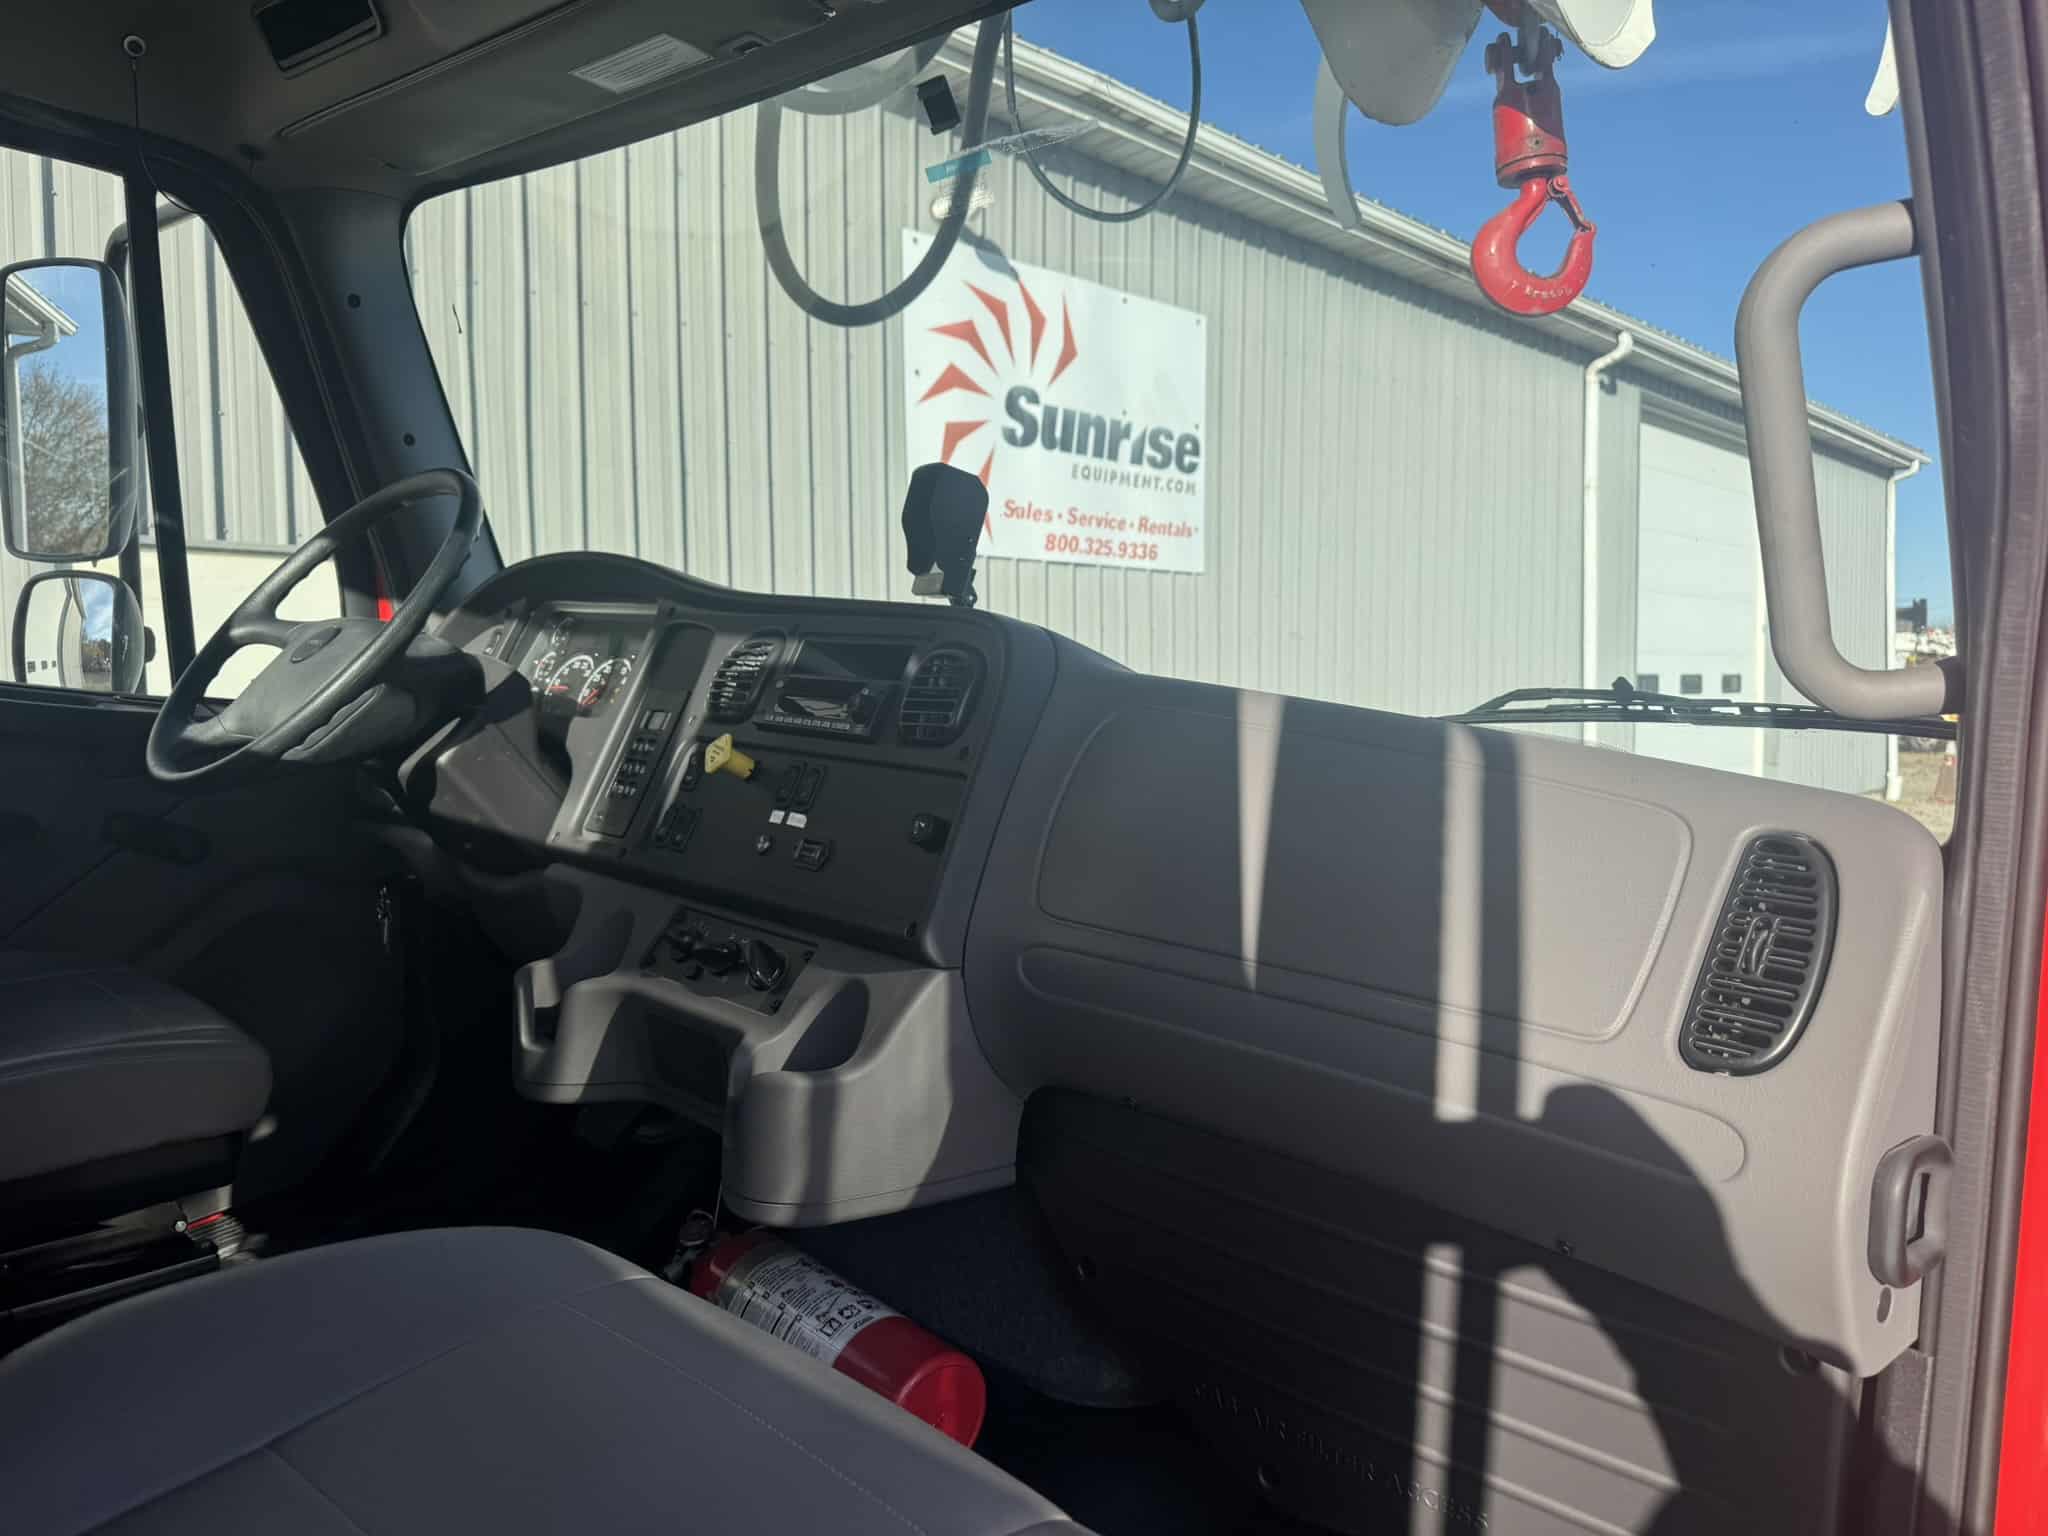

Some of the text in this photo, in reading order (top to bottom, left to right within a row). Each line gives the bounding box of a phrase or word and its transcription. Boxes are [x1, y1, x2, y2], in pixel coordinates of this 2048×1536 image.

[1002, 385, 1200, 475] Sunrise
[1071, 463, 1197, 495] EQUIPMENT.COM
[1003, 499, 1193, 538] Sales Service Rentals
[1044, 533, 1159, 561] 800.325.9336
